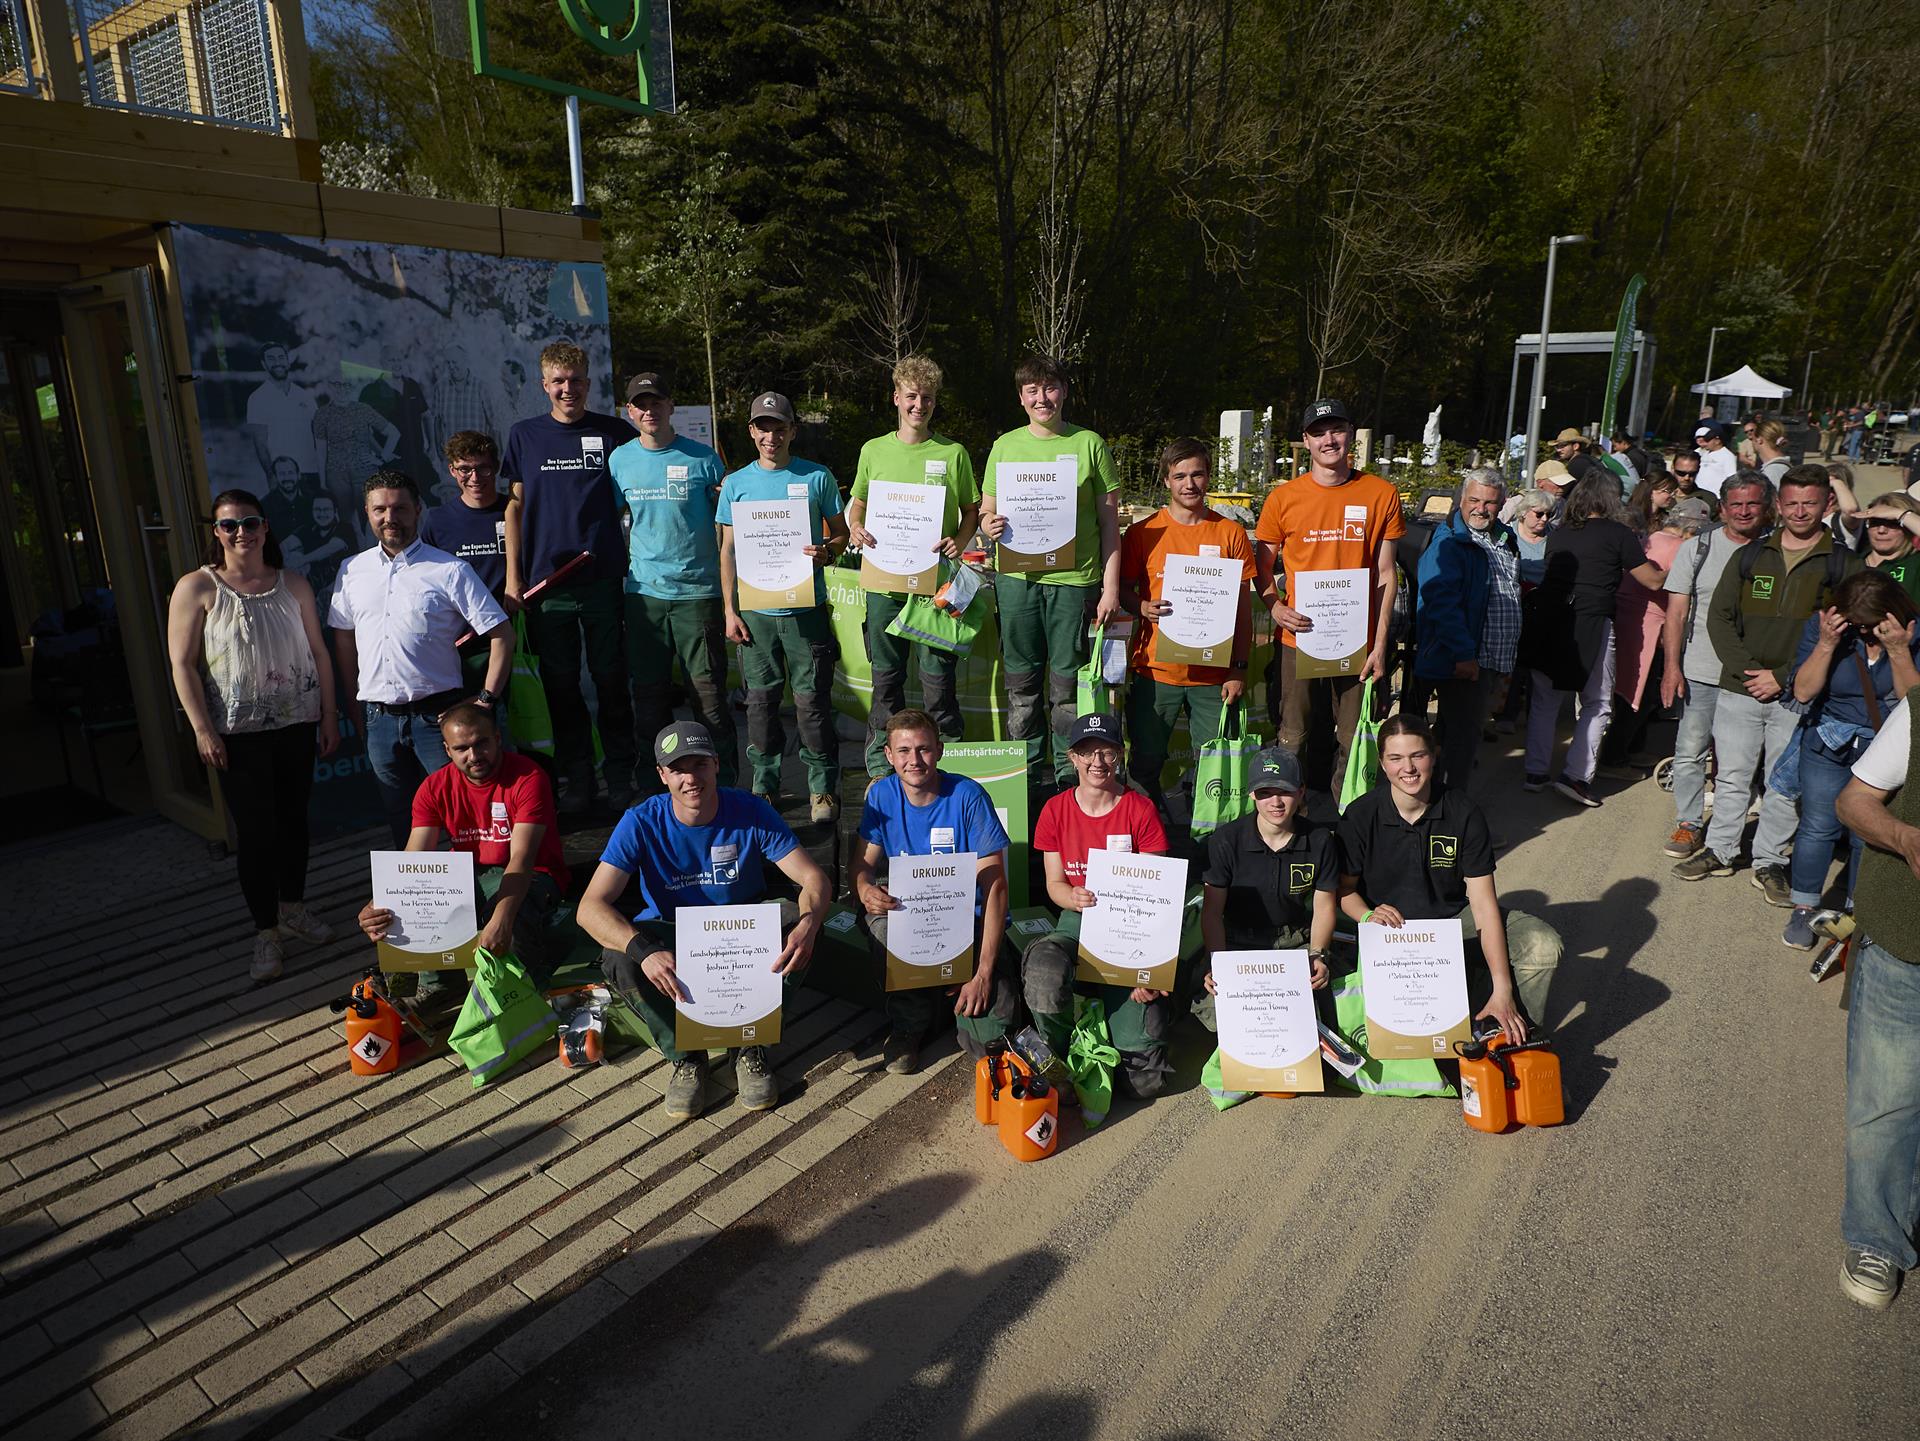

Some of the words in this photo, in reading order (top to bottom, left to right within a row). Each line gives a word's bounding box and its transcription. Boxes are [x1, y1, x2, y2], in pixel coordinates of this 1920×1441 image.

[1017, 473, 1057, 482] URKUNDE
[887, 493, 926, 504] URKUNDE
[752, 511, 791, 520] URKUNDE
[1184, 566, 1223, 577] URKUNDE
[1315, 580, 1352, 589] URKUNDE
[398, 864, 449, 874] URKUNDE
[913, 867, 956, 879] URKUNDE
[1112, 865, 1161, 880] URKUNDE
[685, 879, 713, 887] Landschaft
[910, 906, 933, 915] Michael
[1110, 904, 1127, 914] Jenny
[703, 919, 756, 931] URKUNDE
[1384, 933, 1436, 943] URKUNDE
[706, 963, 729, 973] Joshua
[732, 962, 754, 972] Harrer
[1237, 964, 1286, 974] URKUNDE
